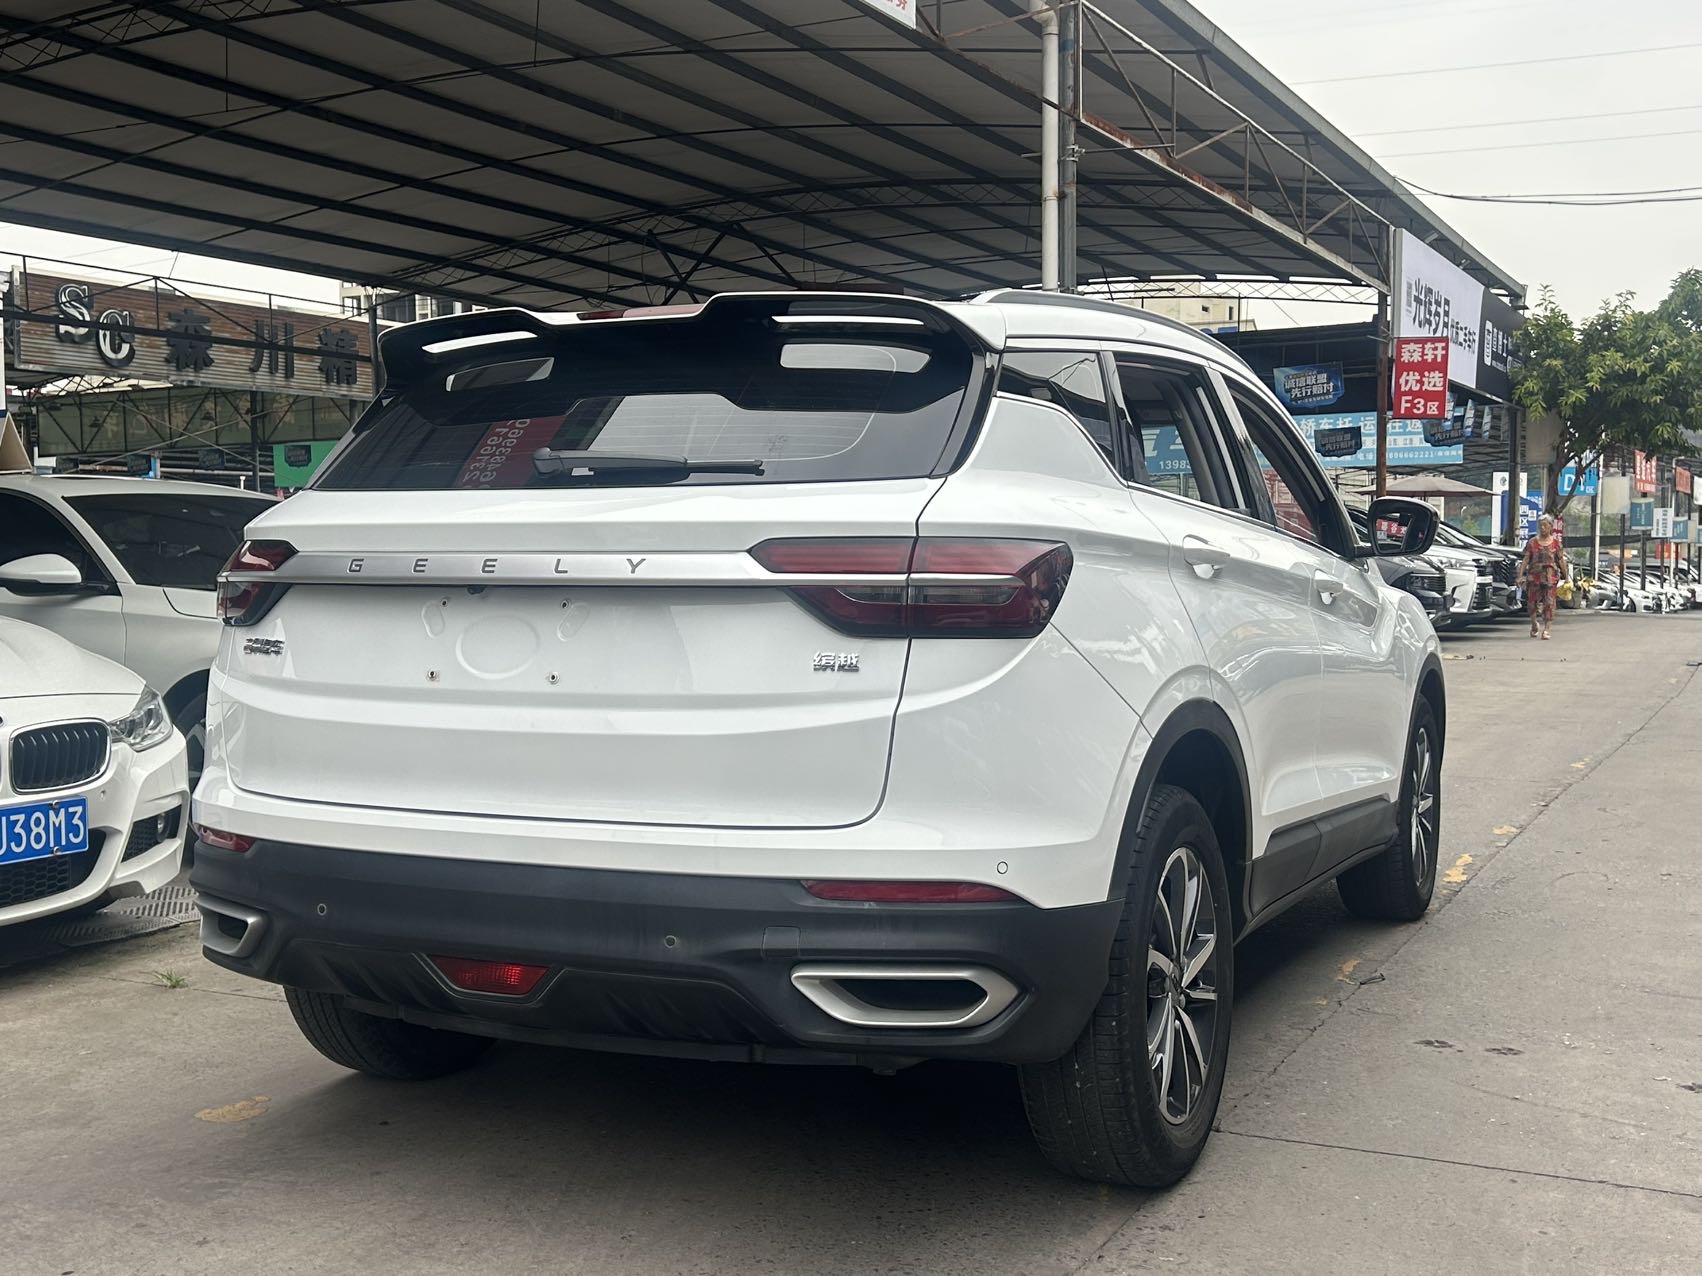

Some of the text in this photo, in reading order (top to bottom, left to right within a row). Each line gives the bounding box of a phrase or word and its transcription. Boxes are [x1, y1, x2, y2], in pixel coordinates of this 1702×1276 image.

[1412, 277, 1450, 337] 光辉岁月
[1401, 342, 1446, 362] 森轩
[1291, 382, 1334, 398] 先行赔付
[1400, 371, 1444, 391] 优选
[1401, 396, 1439, 414] F3区
[347, 558, 646, 574] GEELY
[813, 652, 860, 672] 缤越
